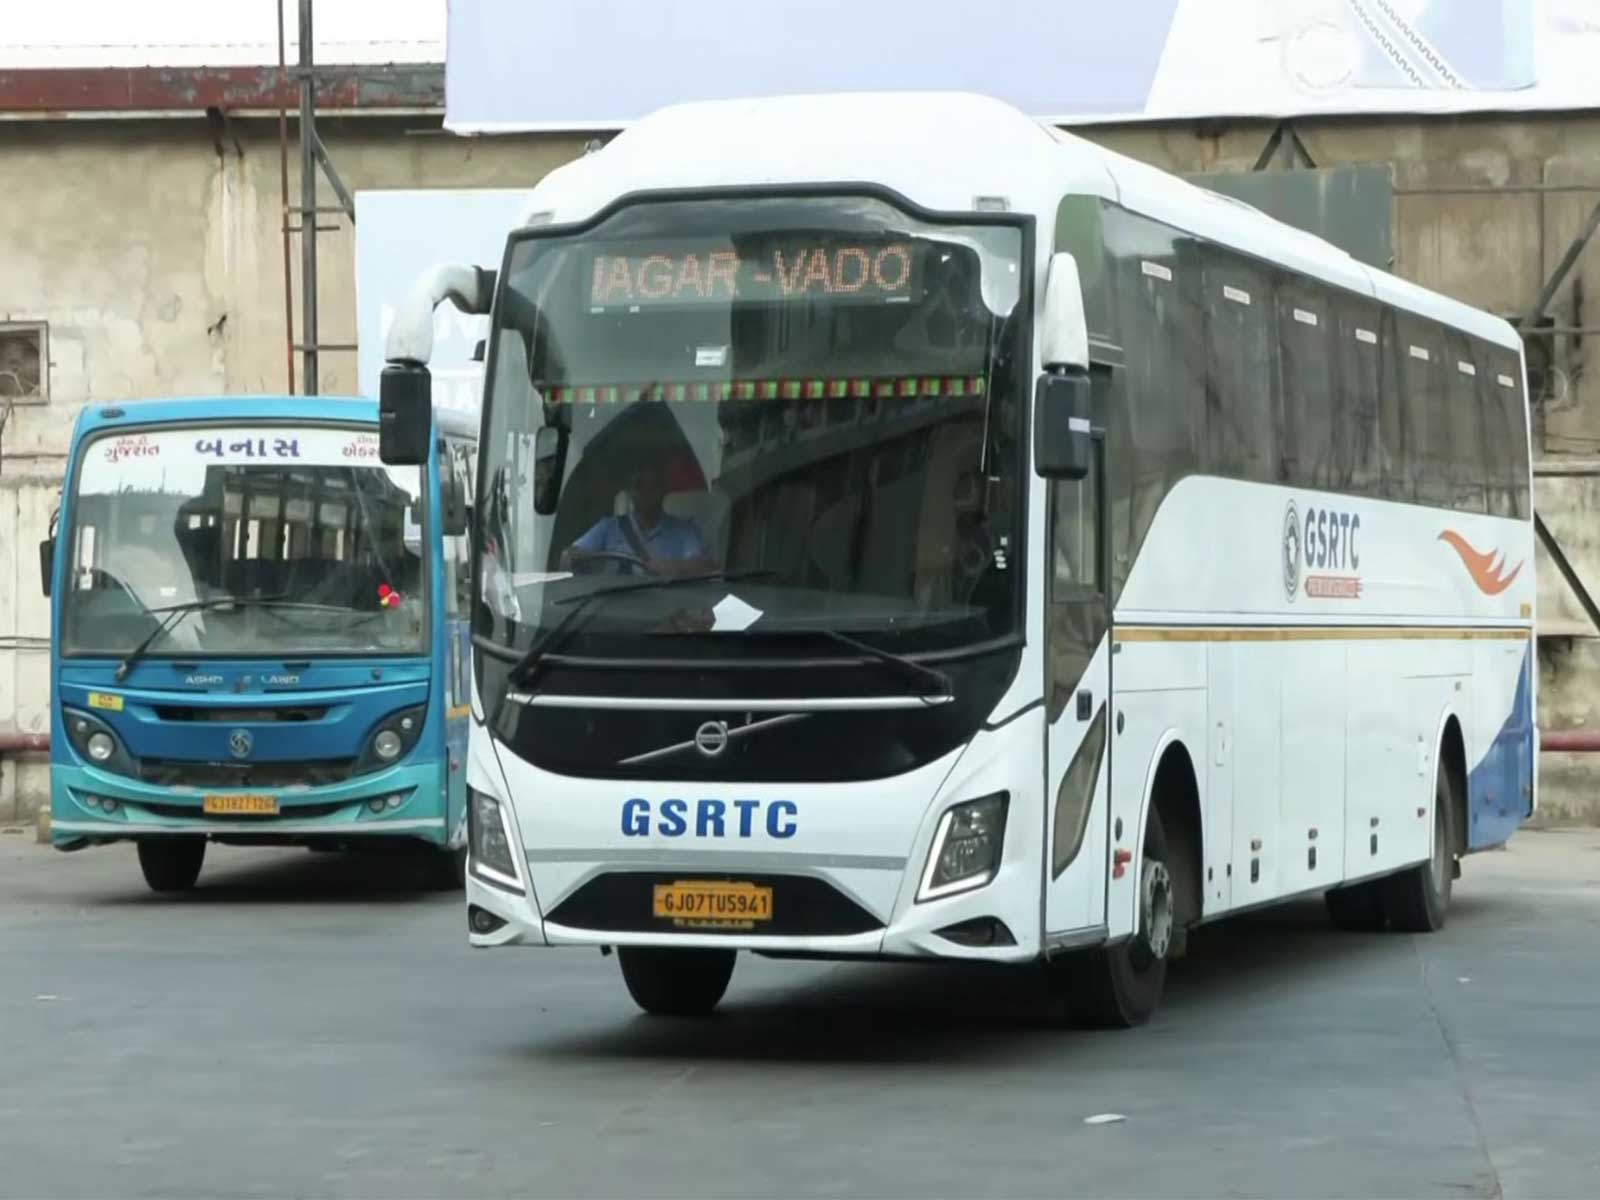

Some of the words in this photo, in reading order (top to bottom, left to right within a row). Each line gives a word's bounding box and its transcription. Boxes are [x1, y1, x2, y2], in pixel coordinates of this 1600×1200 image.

[195, 438, 300, 457] બનાસ
[1303, 506, 1361, 573] GSRTC
[621, 797, 798, 840] GSRTC
[664, 893, 768, 914] GJ07TU5941
